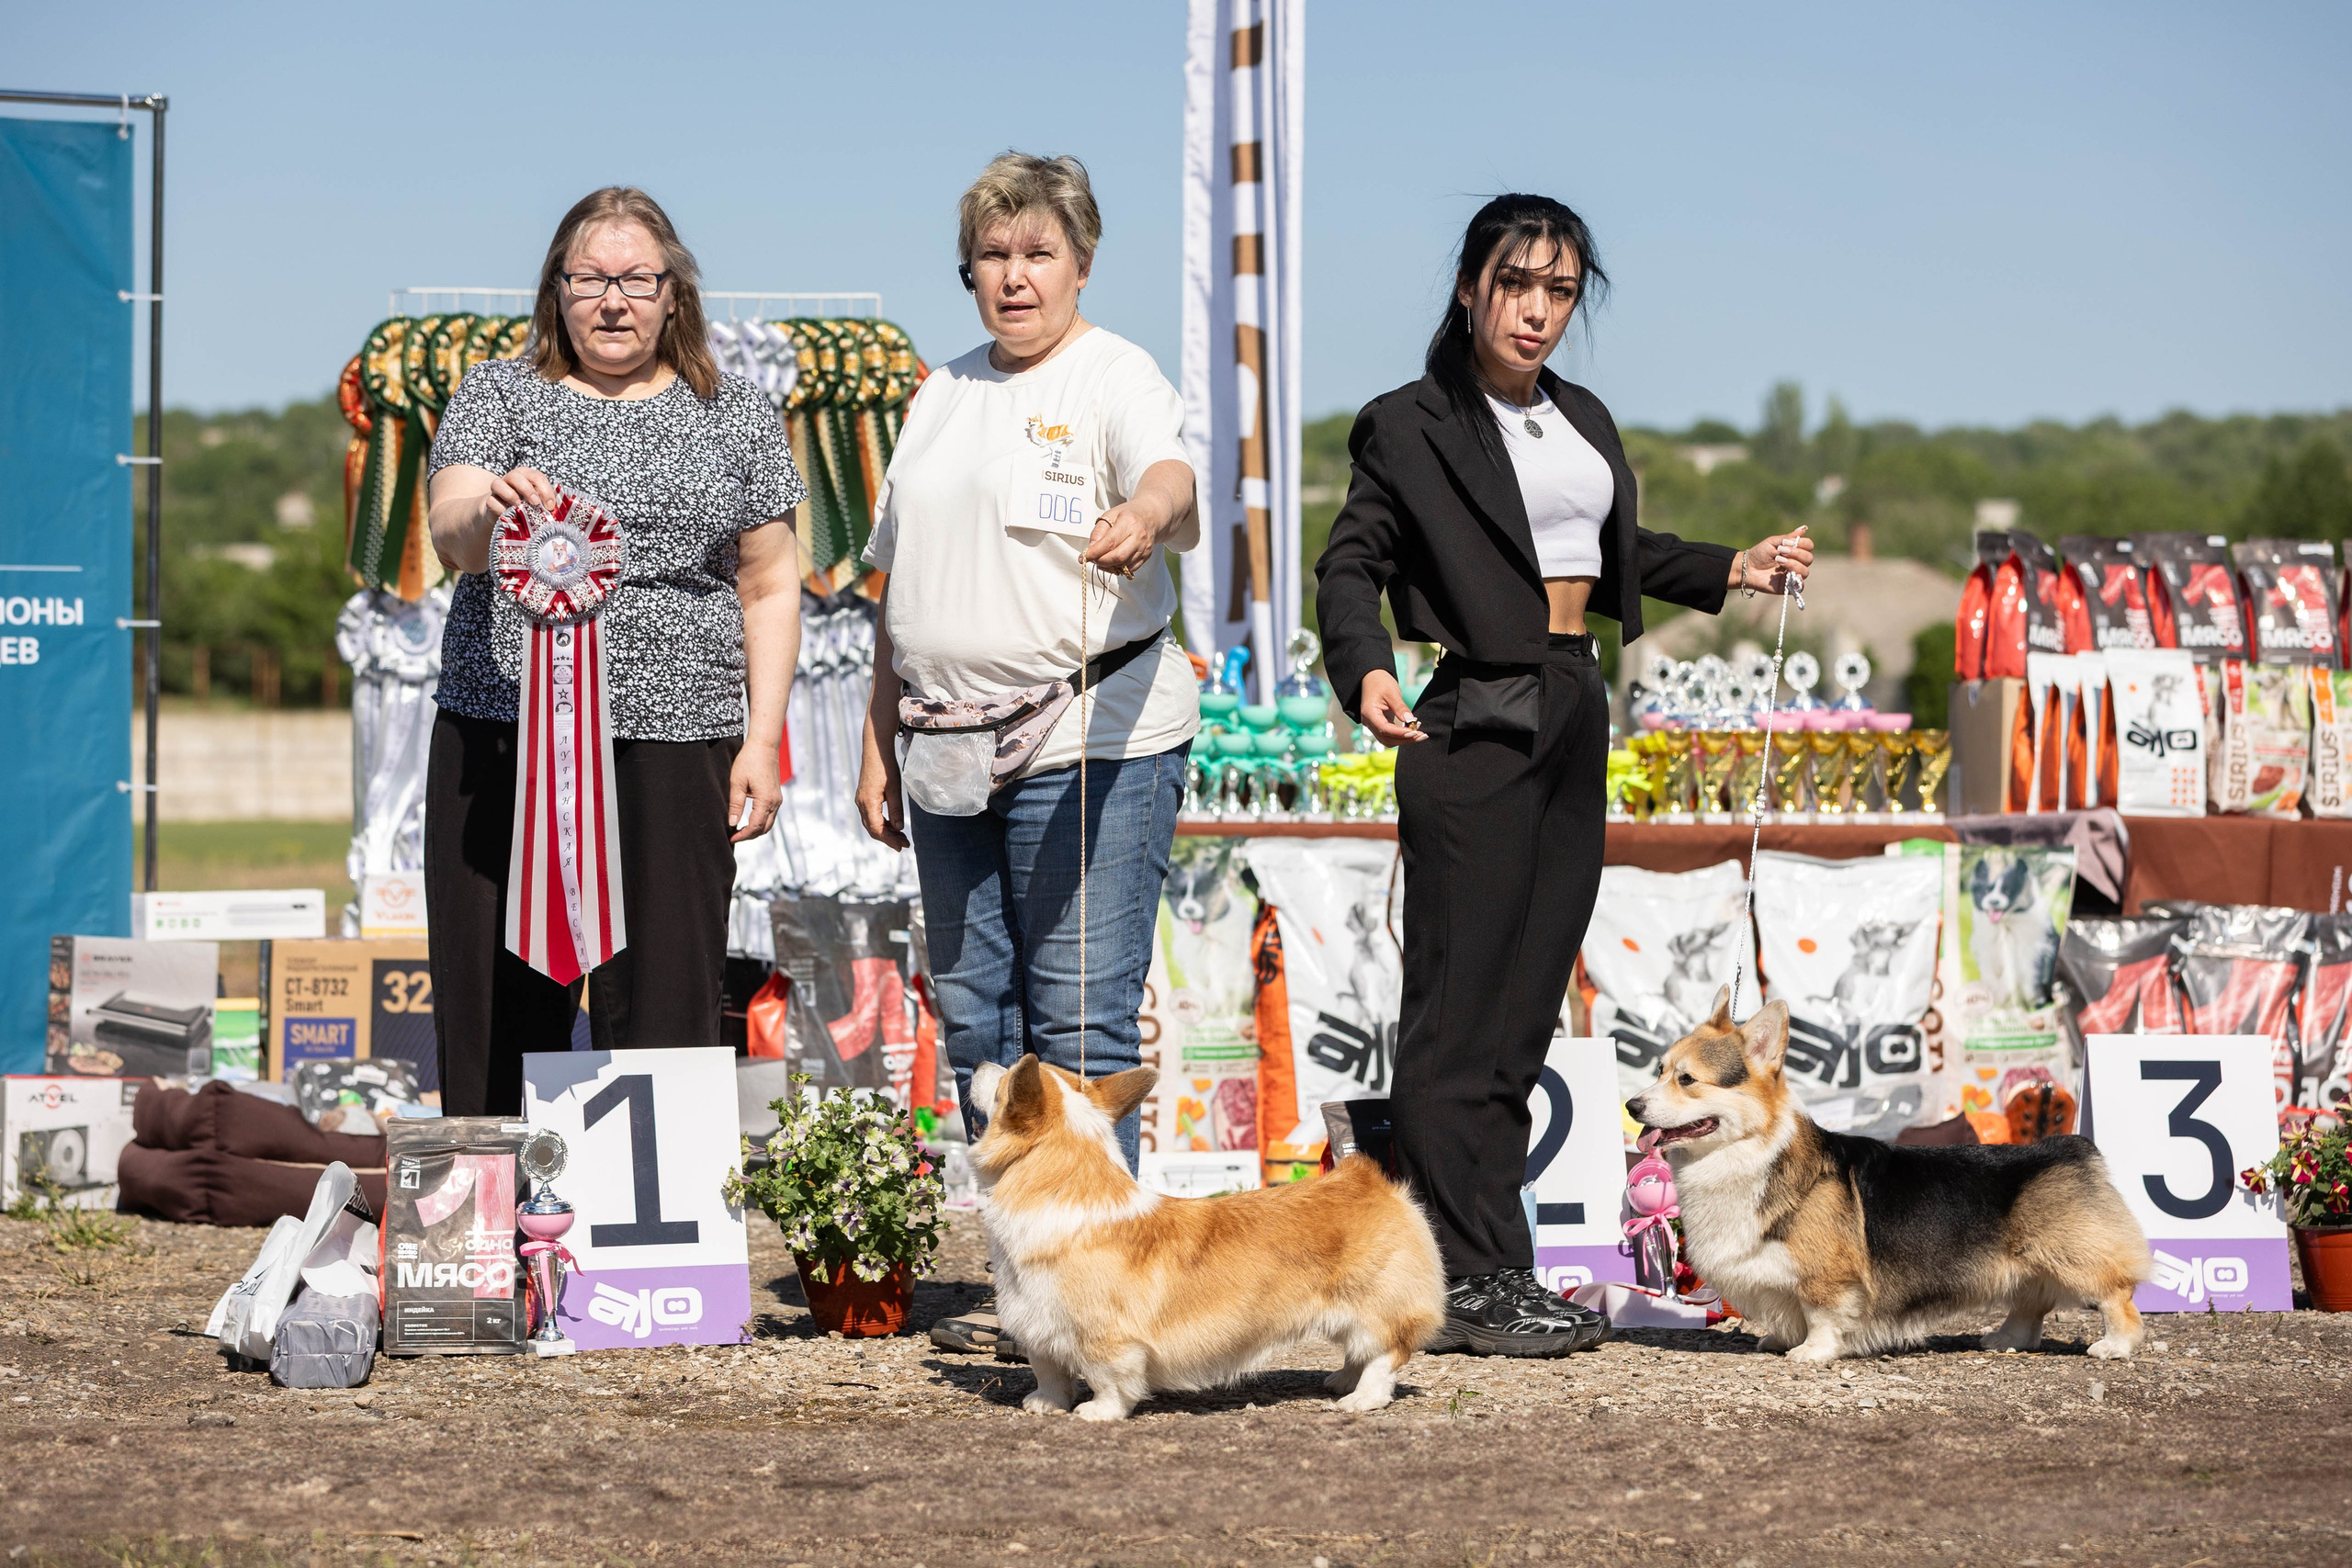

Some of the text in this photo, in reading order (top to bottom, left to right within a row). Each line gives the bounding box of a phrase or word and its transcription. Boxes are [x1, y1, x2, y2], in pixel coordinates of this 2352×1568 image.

[1045, 470, 1085, 486] SIRIUS
[0, 595, 84, 626] ОНЫ
[2228, 723, 2248, 801] SIRIUS
[2321, 731, 2341, 807] SIRIUS
[285, 976, 349, 997] CT-8732
[381, 970, 434, 1014] 32
[285, 998, 323, 1013] Smart
[290, 1023, 350, 1046] SMART
[1521, 1063, 1586, 1225] 2
[2139, 1060, 2235, 1220] 3
[582, 1073, 700, 1248] 1
[465, 1237, 514, 1251] ОДНО
[397, 1262, 514, 1289] МЯСО
